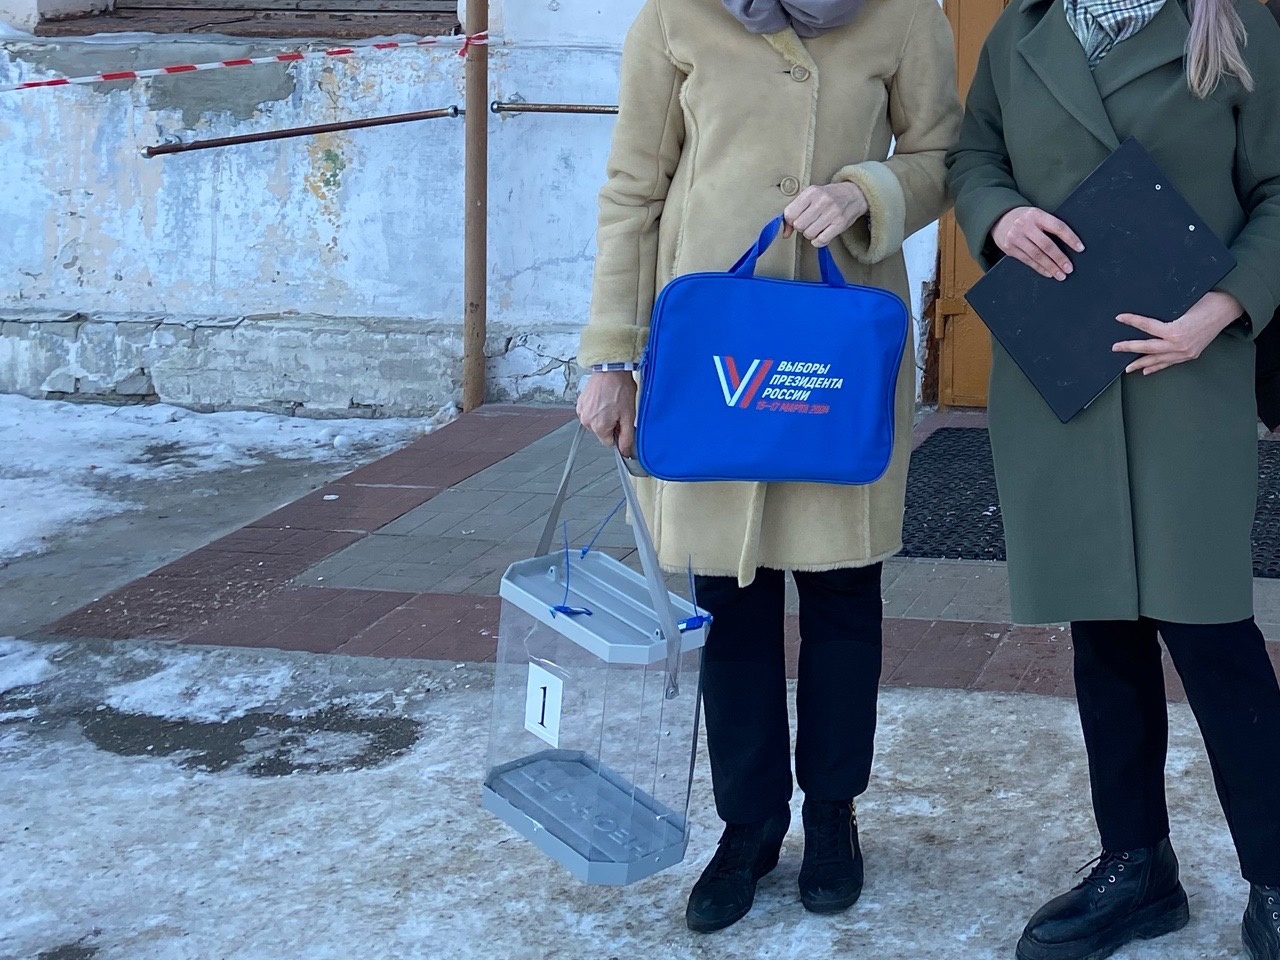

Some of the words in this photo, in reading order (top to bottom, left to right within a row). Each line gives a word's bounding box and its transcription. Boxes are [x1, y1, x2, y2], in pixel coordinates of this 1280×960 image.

[776, 361, 831, 375] ВЫБОРЫ
[769, 374, 844, 389] ПРЕЗИДЕНТА
[761, 387, 811, 401] РОССИИ
[537, 686, 547, 729] 1
